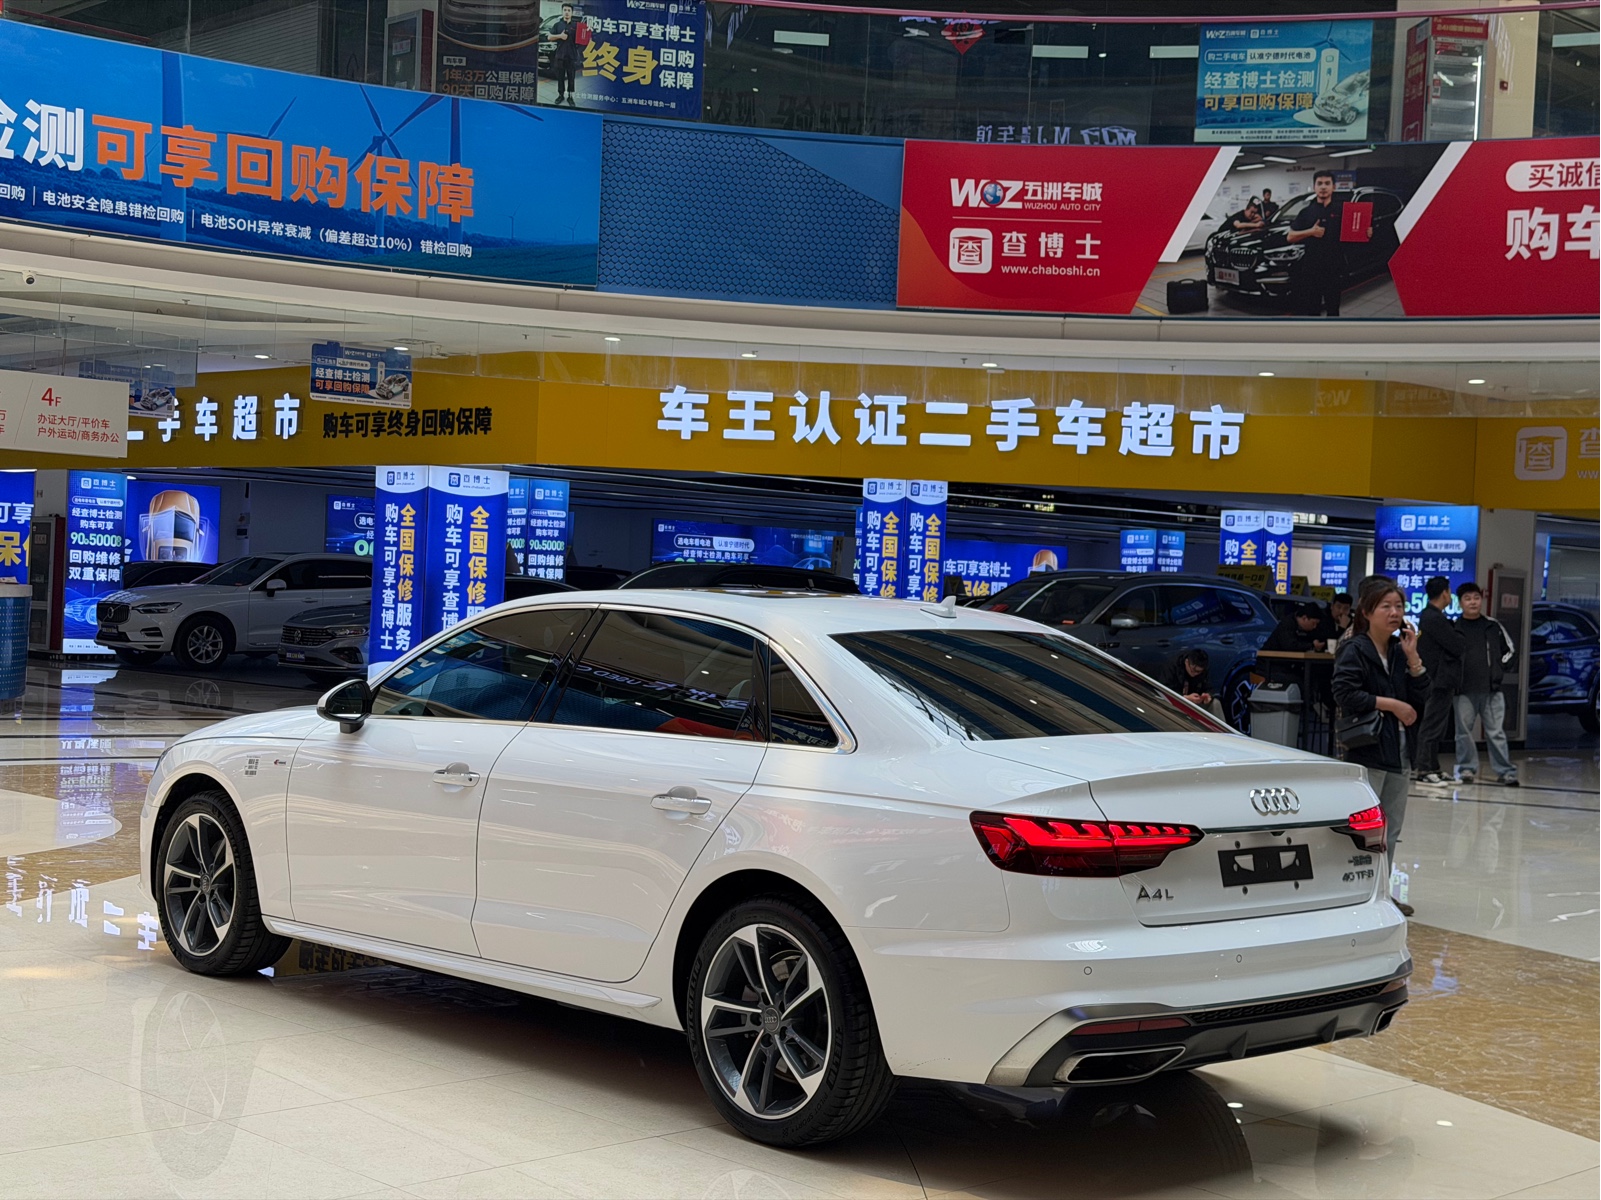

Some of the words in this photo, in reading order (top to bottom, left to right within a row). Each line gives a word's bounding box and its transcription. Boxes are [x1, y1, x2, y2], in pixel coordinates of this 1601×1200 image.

[586, 15, 696, 43] 购车可享查博士
[582, 38, 659, 85] 终身
[660, 48, 695, 68] 回购
[659, 70, 694, 90] 保障
[1204, 69, 1315, 90] 经查博士检测
[1204, 92, 1314, 112] 可享回购保障
[1024, 181, 1102, 202] 五洲车城
[42, 190, 185, 224] 电池安全隐患错检回购
[1060, 203, 1081, 211] AUTO
[1505, 205, 1601, 261] 购车
[1001, 231, 1101, 259] 查博士
[1001, 264, 1101, 276] www.chaboshi.cn
[315, 366, 370, 384] 经查博士检测
[41, 387, 62, 407] 4F
[315, 379, 370, 395] 可享回购保障
[37, 413, 110, 430] 办证大厅/平价车
[323, 406, 493, 439] 购车可享终身回购保障
[657, 385, 1245, 460] 车王认证二手车超市
[37, 426, 120, 444] 户外运动/商务办公
[72, 507, 122, 520] 经查博士检测
[359, 516, 375, 526] 选电
[80, 519, 114, 530] 购车可享
[69, 549, 121, 565] 回购维修
[528, 554, 564, 567] 回购维修
[864, 510, 881, 596] 购车可享
[880, 510, 899, 599] 全国保修
[907, 511, 924, 600] 购车可享
[922, 513, 941, 602] 全国保修
[68, 566, 120, 582] 双重保障
[943, 558, 1012, 578] 车可享查博士
[1385, 557, 1464, 572] 经查博士检测
[380, 503, 399, 650] 购车可享查博士
[395, 503, 416, 651] 全国保修服务
